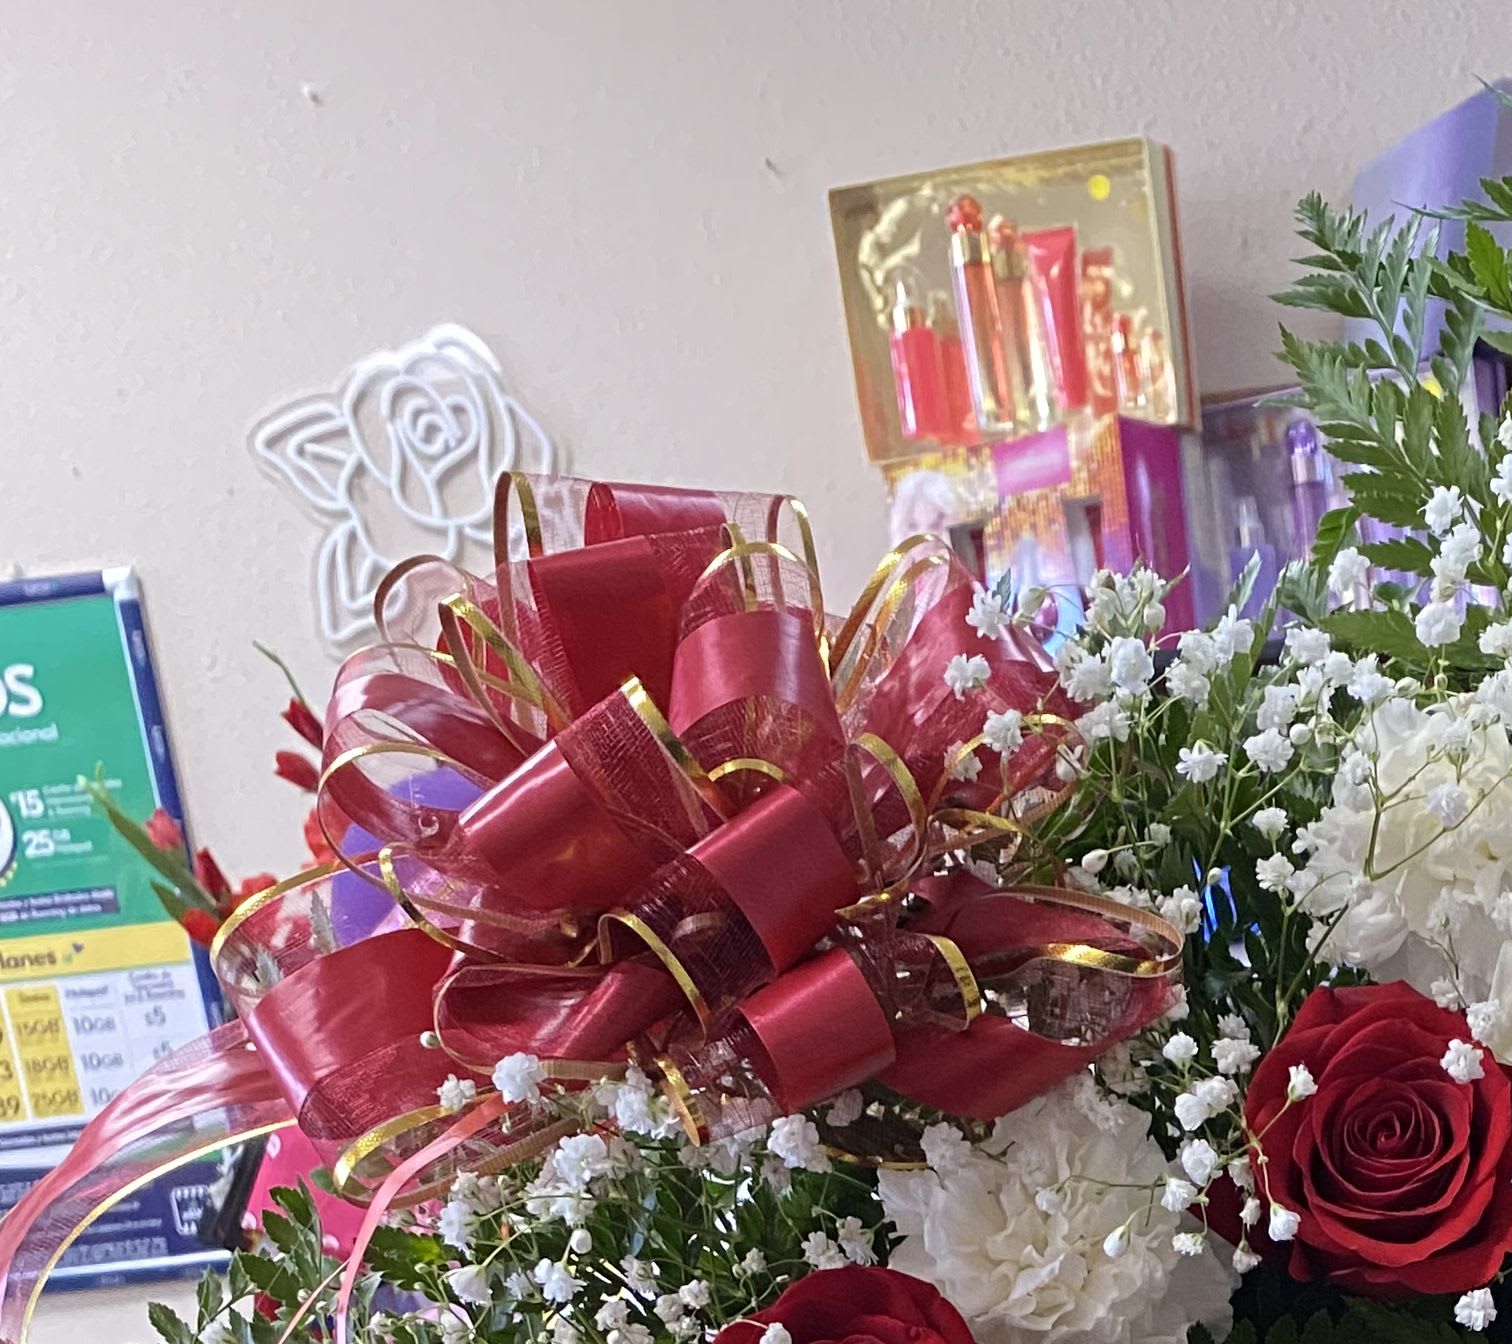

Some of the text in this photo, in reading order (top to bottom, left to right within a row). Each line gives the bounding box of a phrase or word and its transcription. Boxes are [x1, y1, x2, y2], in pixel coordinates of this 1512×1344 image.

[0, 663, 43, 718] S
[9, 789, 45, 819] 15
[22, 829, 55, 858] 25
